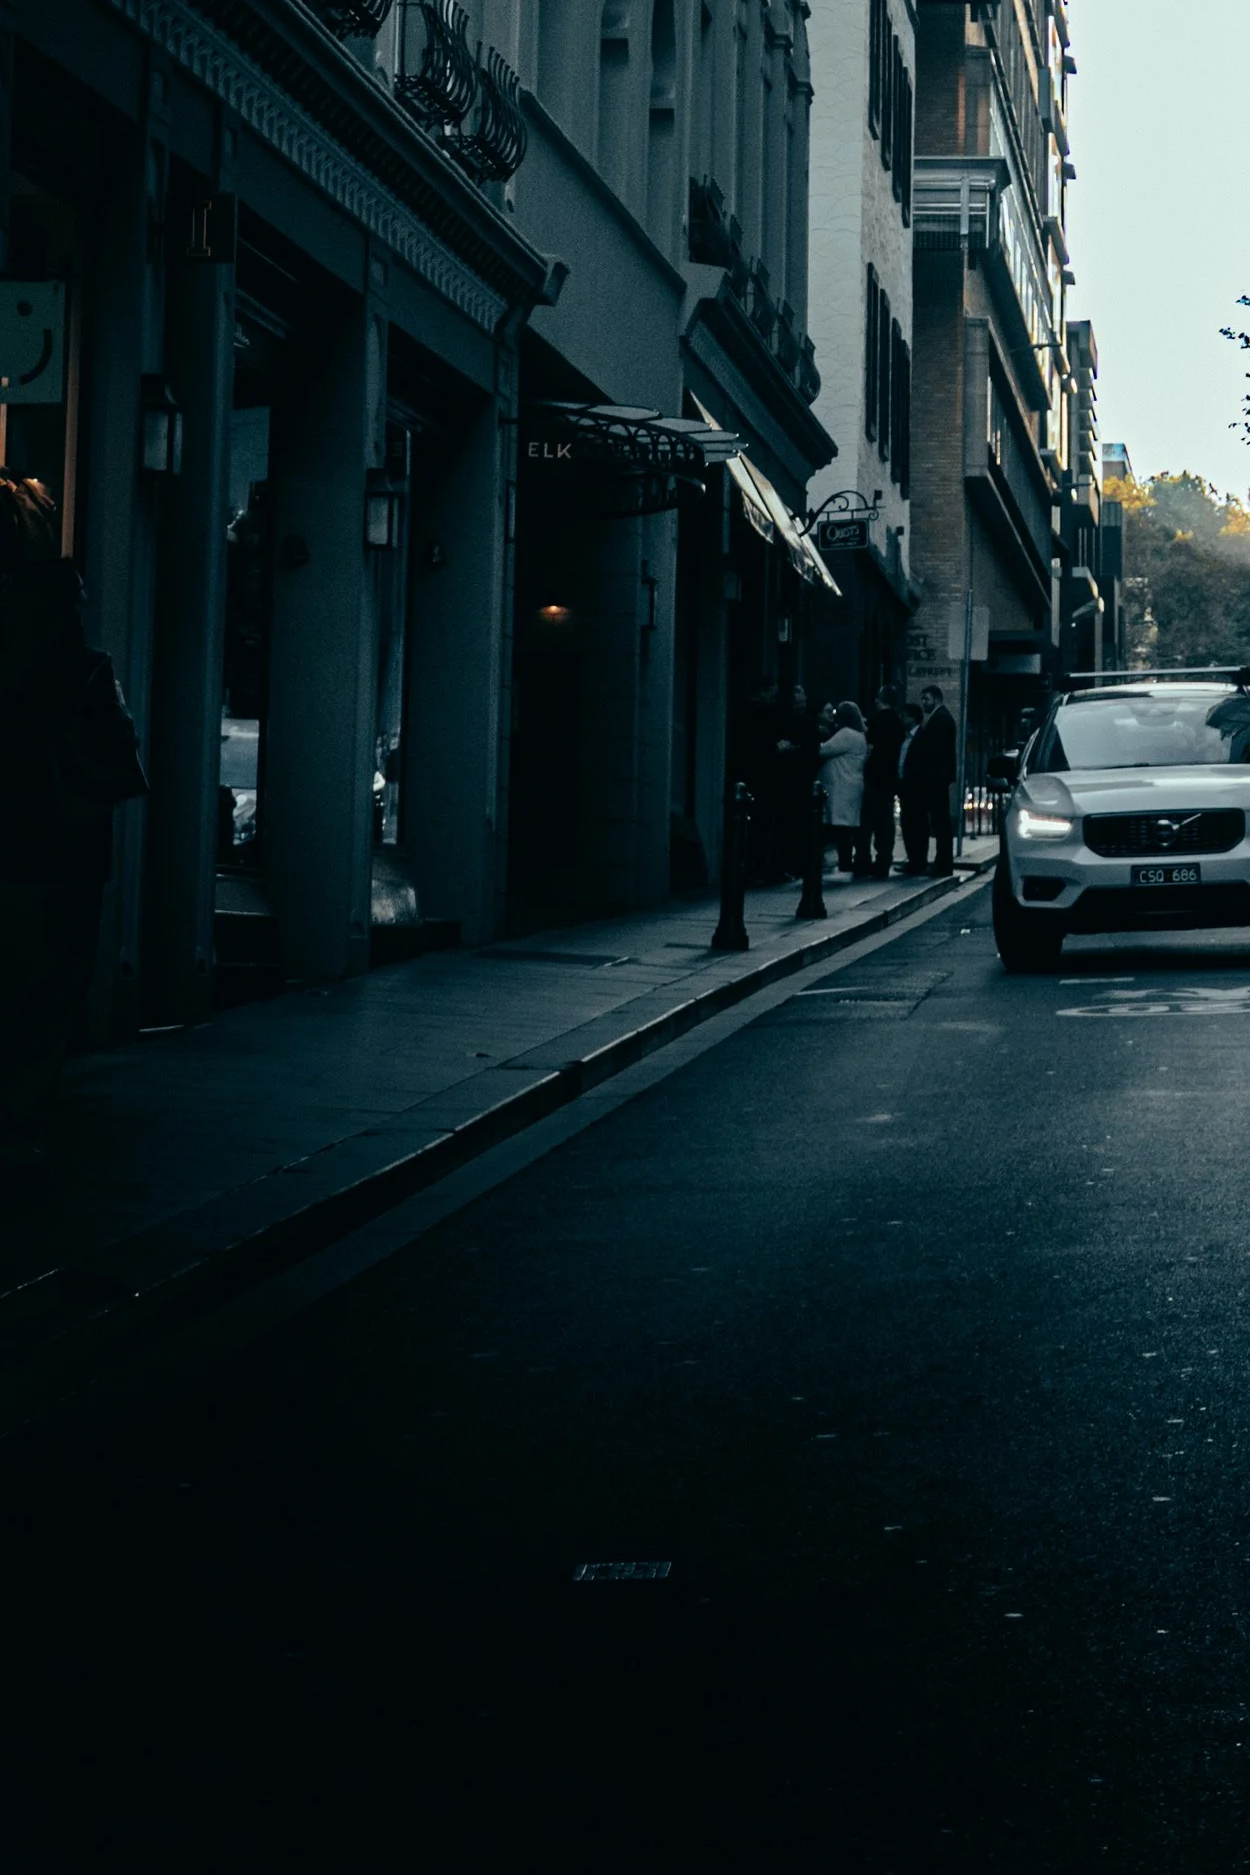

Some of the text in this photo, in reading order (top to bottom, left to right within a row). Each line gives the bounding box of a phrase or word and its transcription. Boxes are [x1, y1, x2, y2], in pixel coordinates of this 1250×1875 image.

[528, 441, 573, 459] ELK
[1140, 868, 1197, 883] CSQ 686
